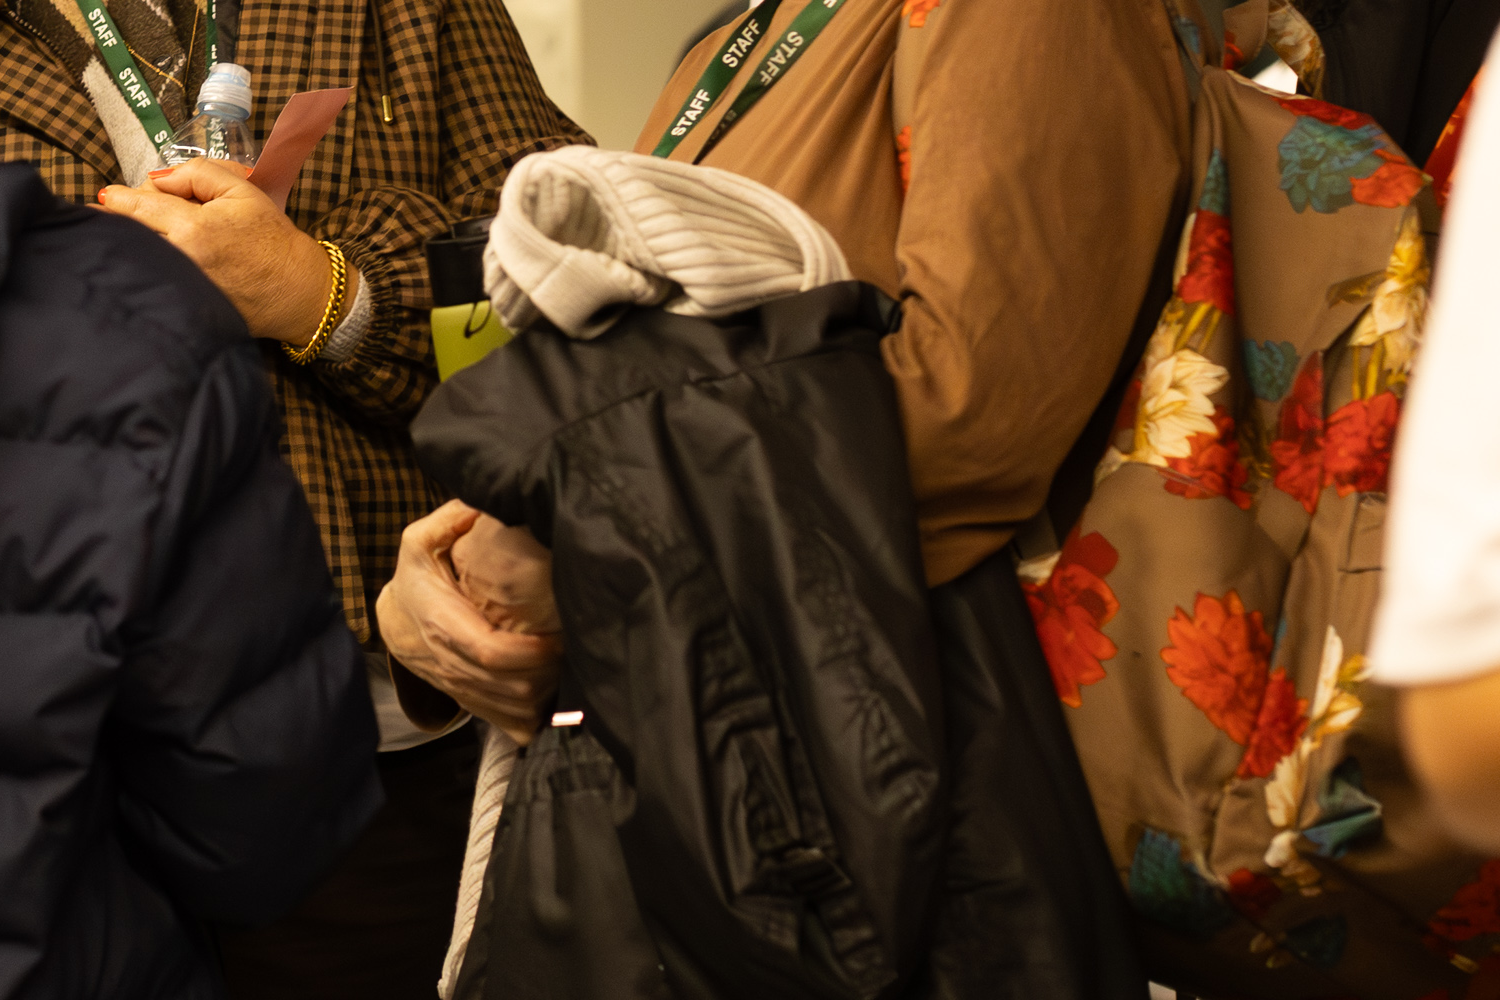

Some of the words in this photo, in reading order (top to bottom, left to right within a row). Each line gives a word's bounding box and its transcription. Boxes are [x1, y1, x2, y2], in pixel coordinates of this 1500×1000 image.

[88, 7, 118, 48] STAFF
[119, 67, 152, 109] STAFF
[670, 88, 711, 137] STAFF
[722, 18, 760, 68] STAFF
[759, 31, 804, 87] STAFF
